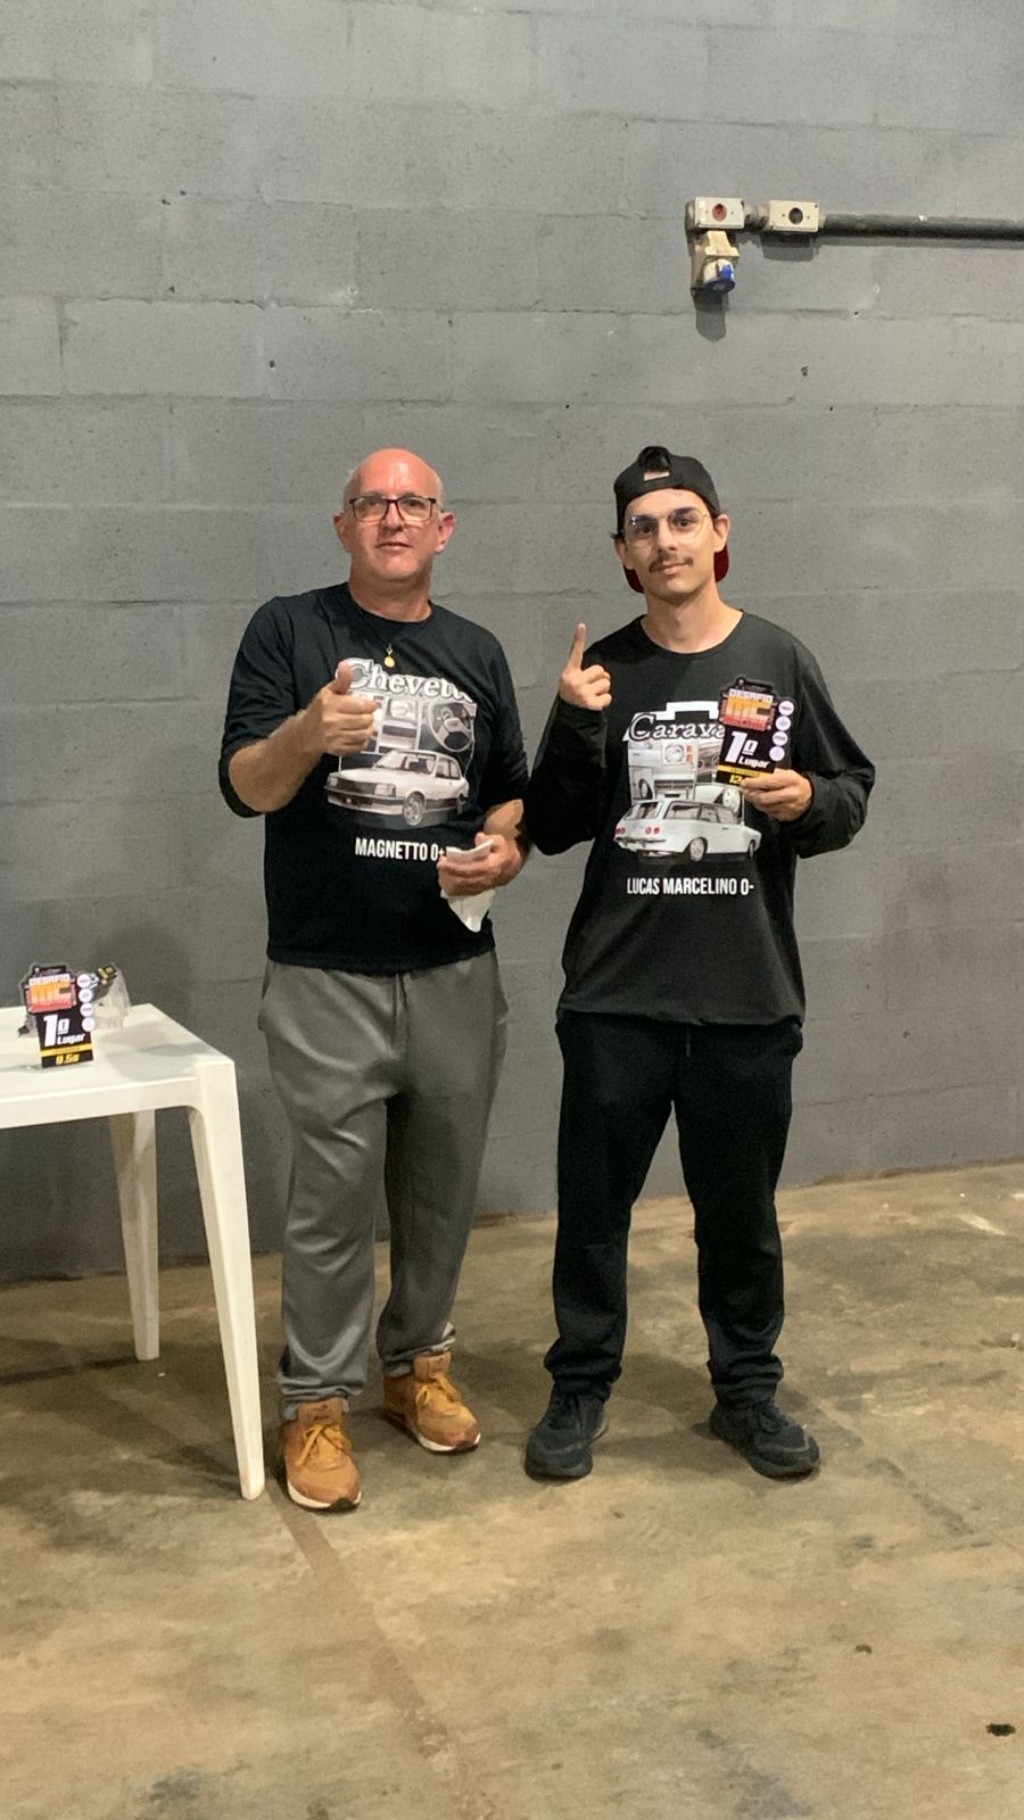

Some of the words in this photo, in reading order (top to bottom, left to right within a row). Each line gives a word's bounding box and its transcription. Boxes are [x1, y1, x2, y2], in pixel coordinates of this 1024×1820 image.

[629, 714, 726, 741] Carava
[738, 756, 770, 768] Lugar
[355, 837, 428, 861] MAGNETTO
[627, 877, 660, 895] LUCAS
[662, 877, 738, 895] MARCELINO
[57, 1033, 86, 1045] Lugar
